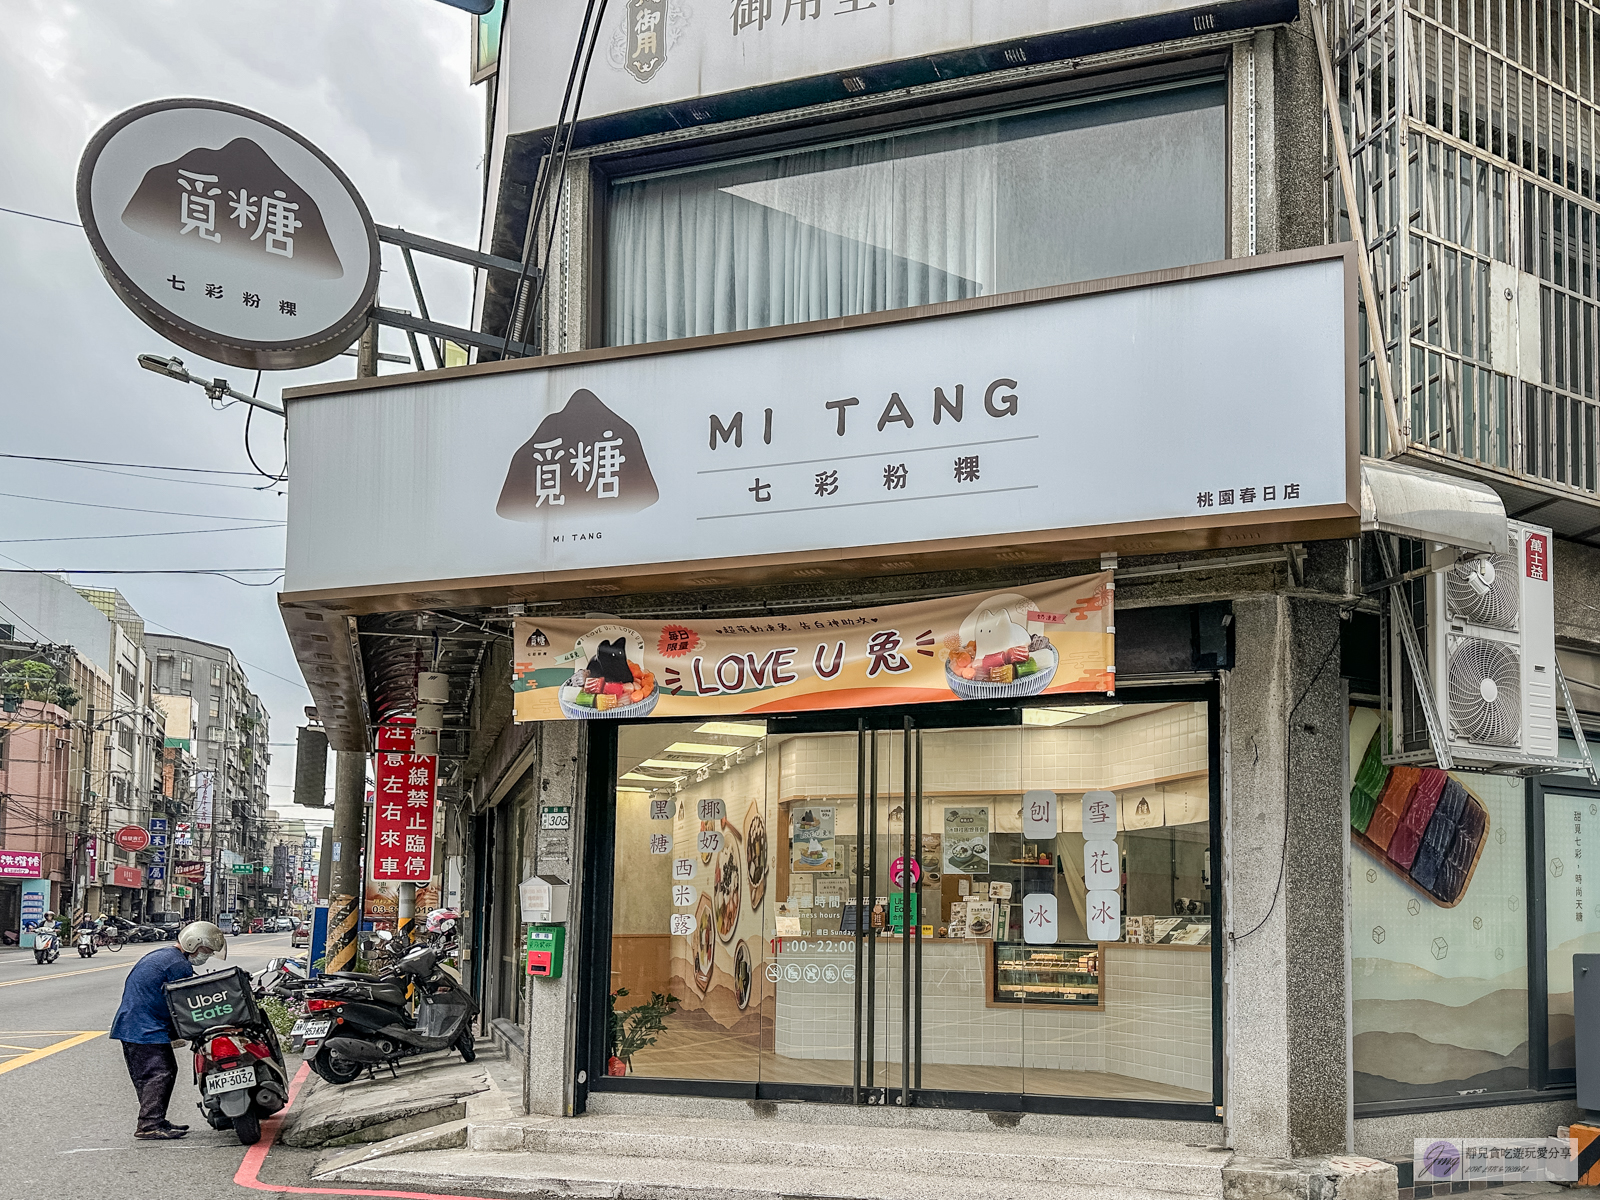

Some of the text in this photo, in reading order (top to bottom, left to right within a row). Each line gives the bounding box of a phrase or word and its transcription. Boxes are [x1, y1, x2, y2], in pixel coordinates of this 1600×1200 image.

[176, 168, 303, 259] 覓糖
[167, 275, 297, 317] 七彩粉粿
[709, 378, 1019, 451] MI TANG
[532, 430, 626, 508] 覓糖
[748, 455, 980, 503] 七彩粉粿
[1196, 483, 1300, 508] 桃園春日店
[552, 531, 603, 543] MI TANG
[1530, 538, 1544, 580] 萬士益
[668, 629, 690, 641] 每日
[799, 616, 870, 630] 告白神助攻
[665, 641, 689, 652] 限量
[692, 629, 913, 697] LOVE U 兔
[379, 721, 407, 876] 注意左右來車
[403, 729, 431, 876] 狀線禁止臨停
[549, 815, 568, 826] 305
[650, 800, 669, 854] 黑糖
[700, 800, 720, 851] 椰奶
[1028, 801, 1051, 927] 刨冰
[1088, 801, 1115, 925] 雪花冰
[673, 860, 692, 935] 西米露
[787, 896, 840, 908] 營業時間
[830, 929, 856, 937] Sunday
[187, 990, 228, 1009] Uber
[191, 1003, 234, 1022] Eats
[209, 1072, 254, 1091] MKP-3032
